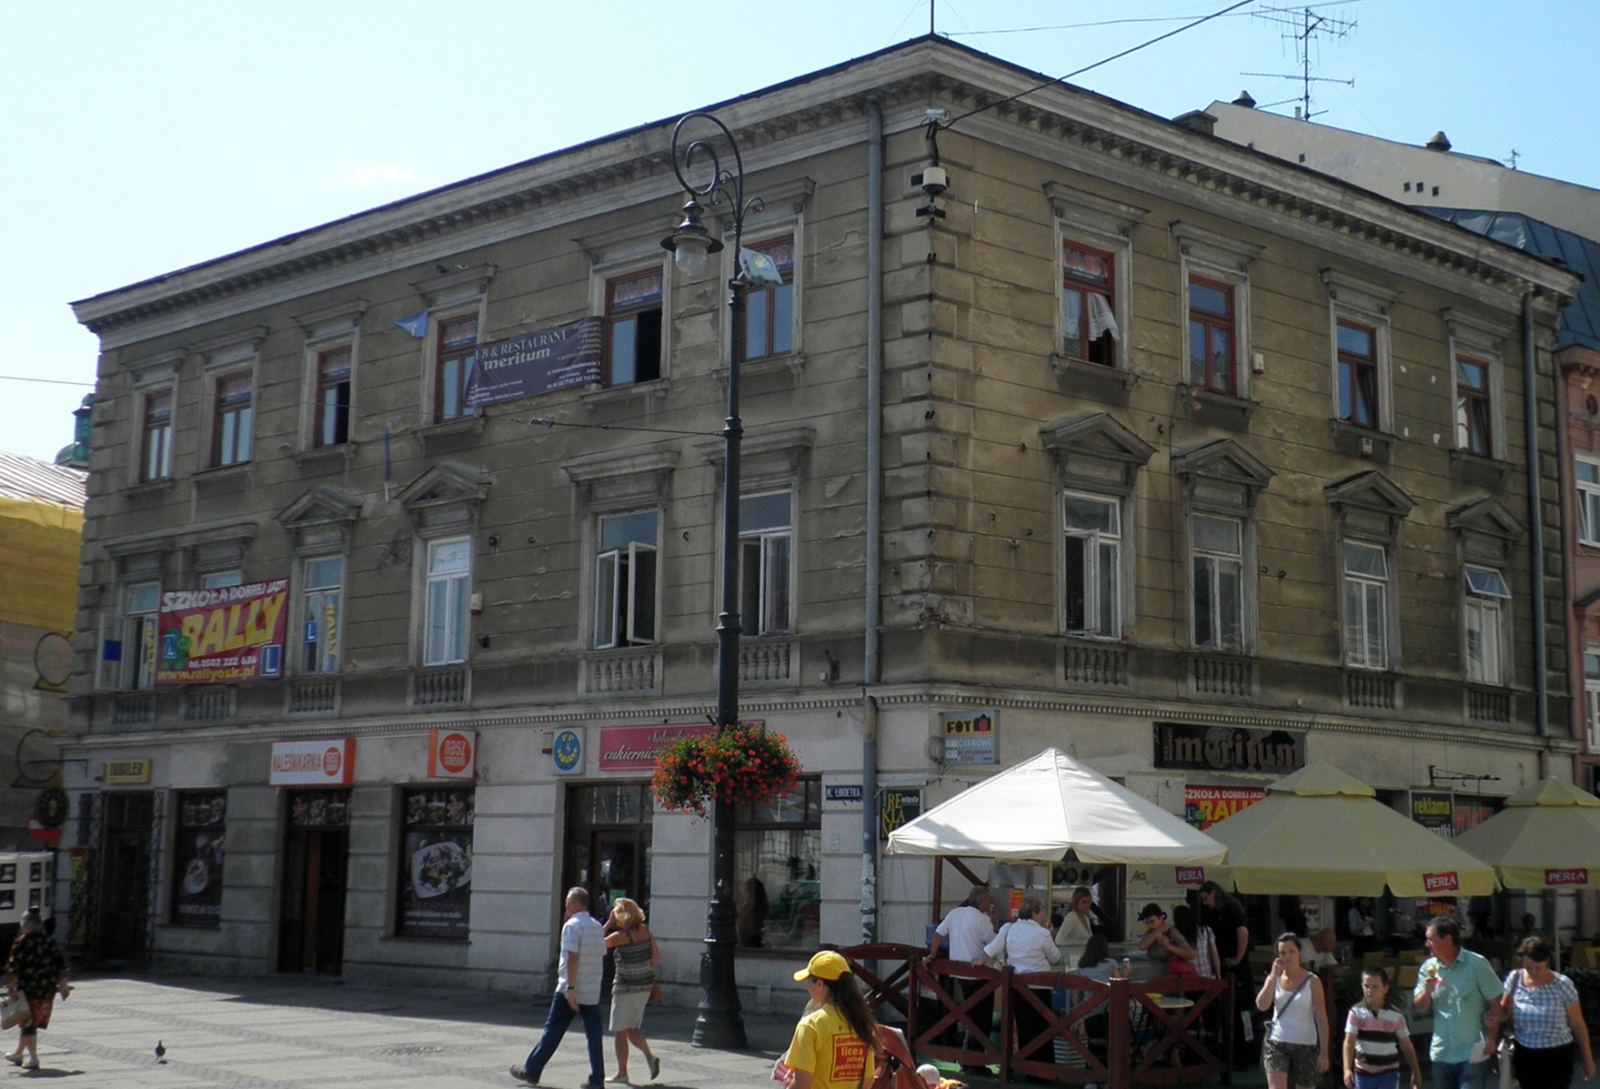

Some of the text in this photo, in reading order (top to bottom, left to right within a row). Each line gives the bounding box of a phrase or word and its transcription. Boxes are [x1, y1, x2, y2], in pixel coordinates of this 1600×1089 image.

[500, 330, 568, 357] RESTAURANT
[483, 348, 551, 371] meritum
[181, 591, 288, 658] RALLY
[307, 626, 315, 640] L
[265, 647, 277, 673] L
[1173, 732, 1299, 768] meritum
[1414, 796, 1451, 816] reklama
[1426, 874, 1456, 889] PERŁA
[1549, 870, 1586, 882] PERŁA
